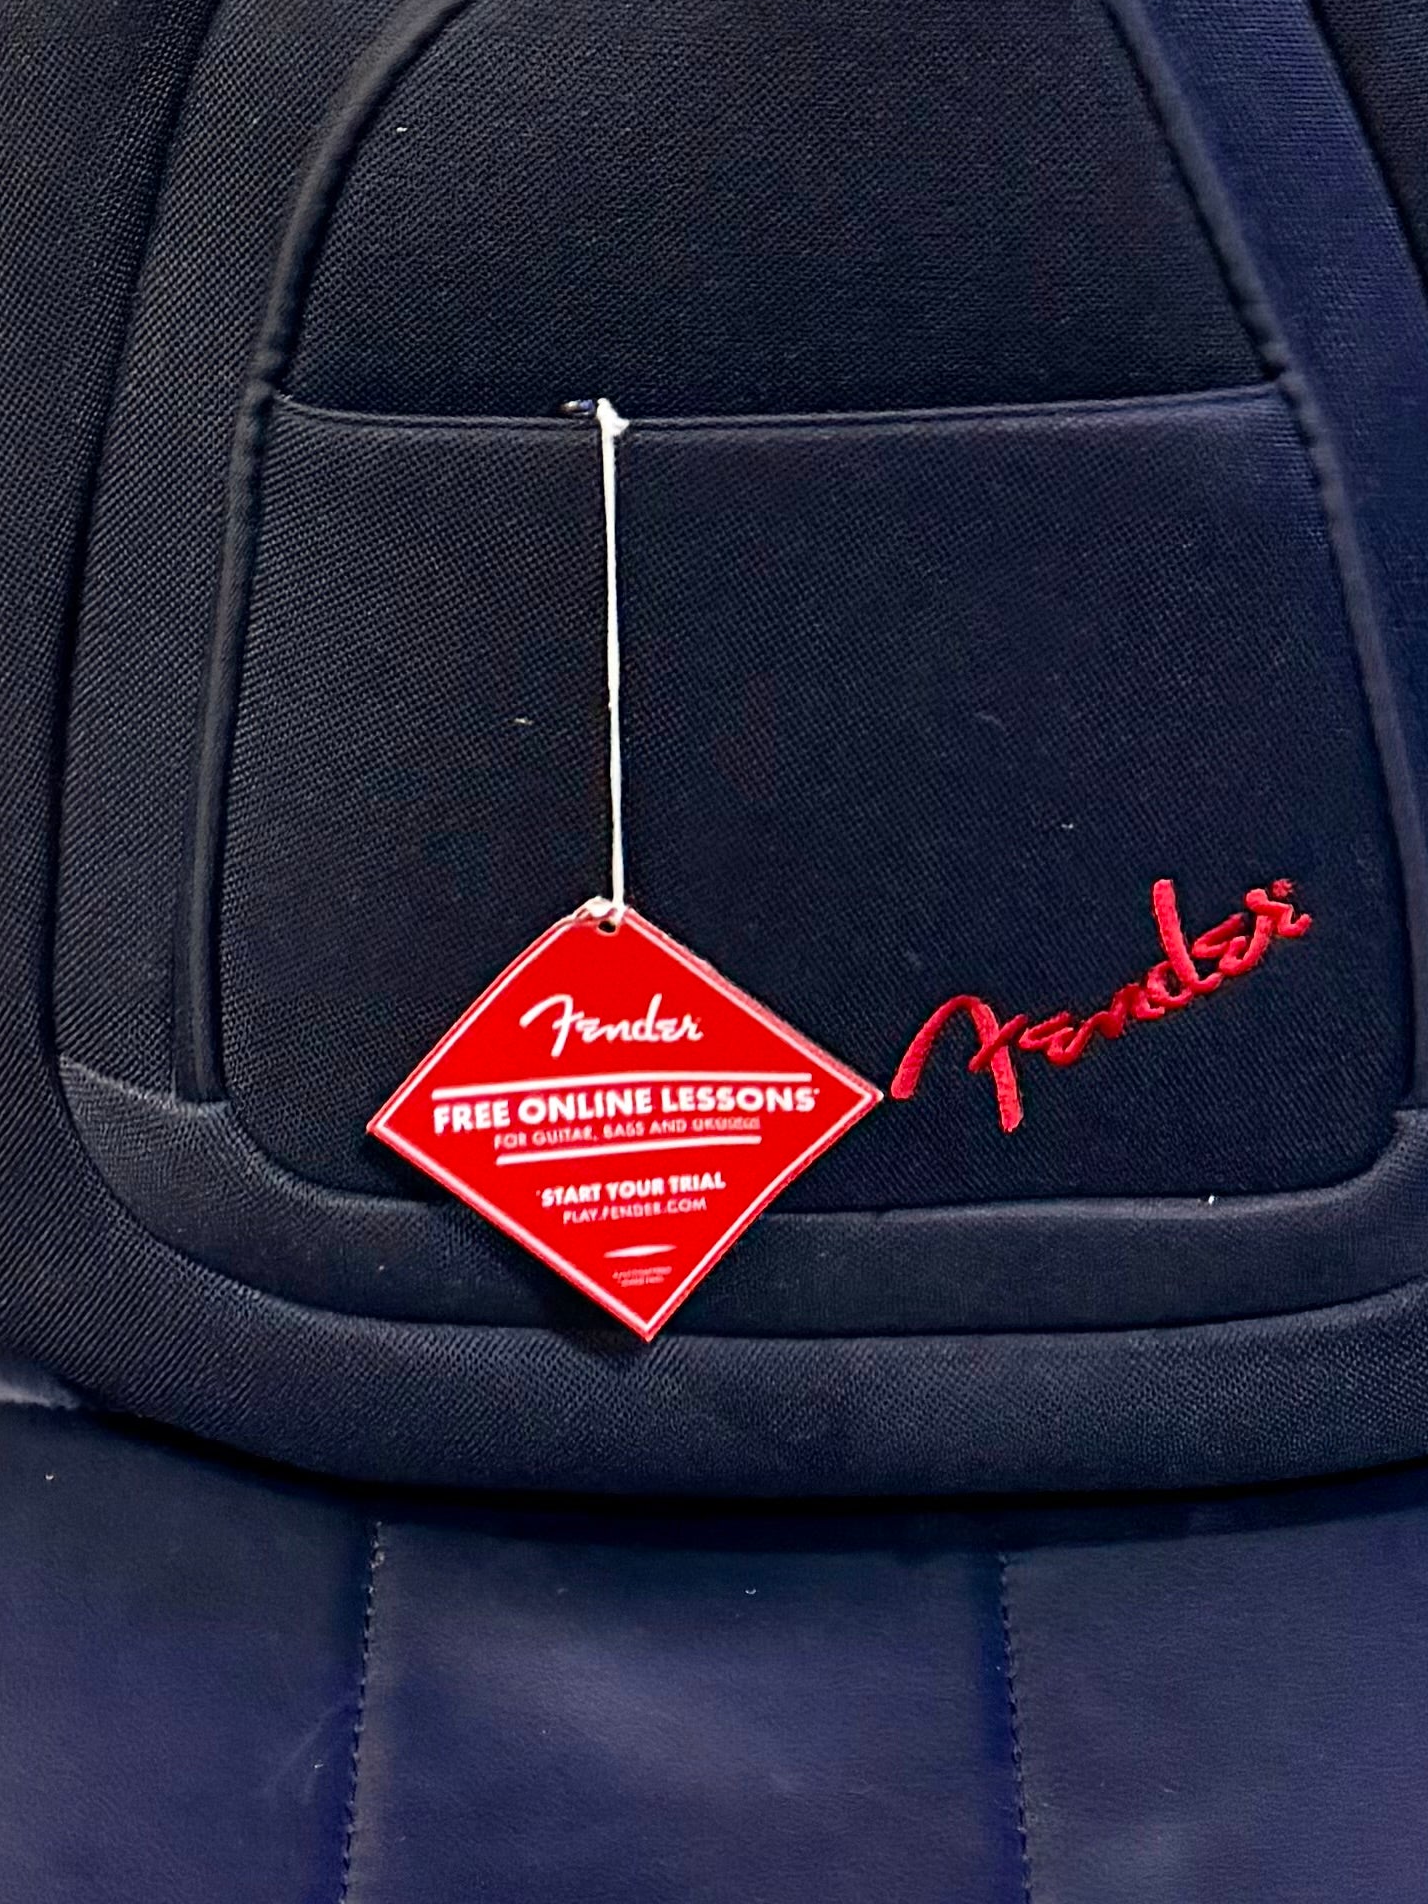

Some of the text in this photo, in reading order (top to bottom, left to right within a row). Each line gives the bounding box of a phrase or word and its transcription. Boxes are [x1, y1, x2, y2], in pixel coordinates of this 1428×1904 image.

[519, 993, 704, 1058] Fender
[890, 878, 1312, 1133] Fender
[433, 1099, 510, 1134] FREE
[517, 1091, 653, 1124] ONLINE
[494, 1132, 527, 1150] FOR
[603, 1120, 645, 1139] BASS
[649, 1117, 687, 1135] AND
[606, 1178, 665, 1199] YOUR
[668, 1171, 726, 1191] TRIAL
